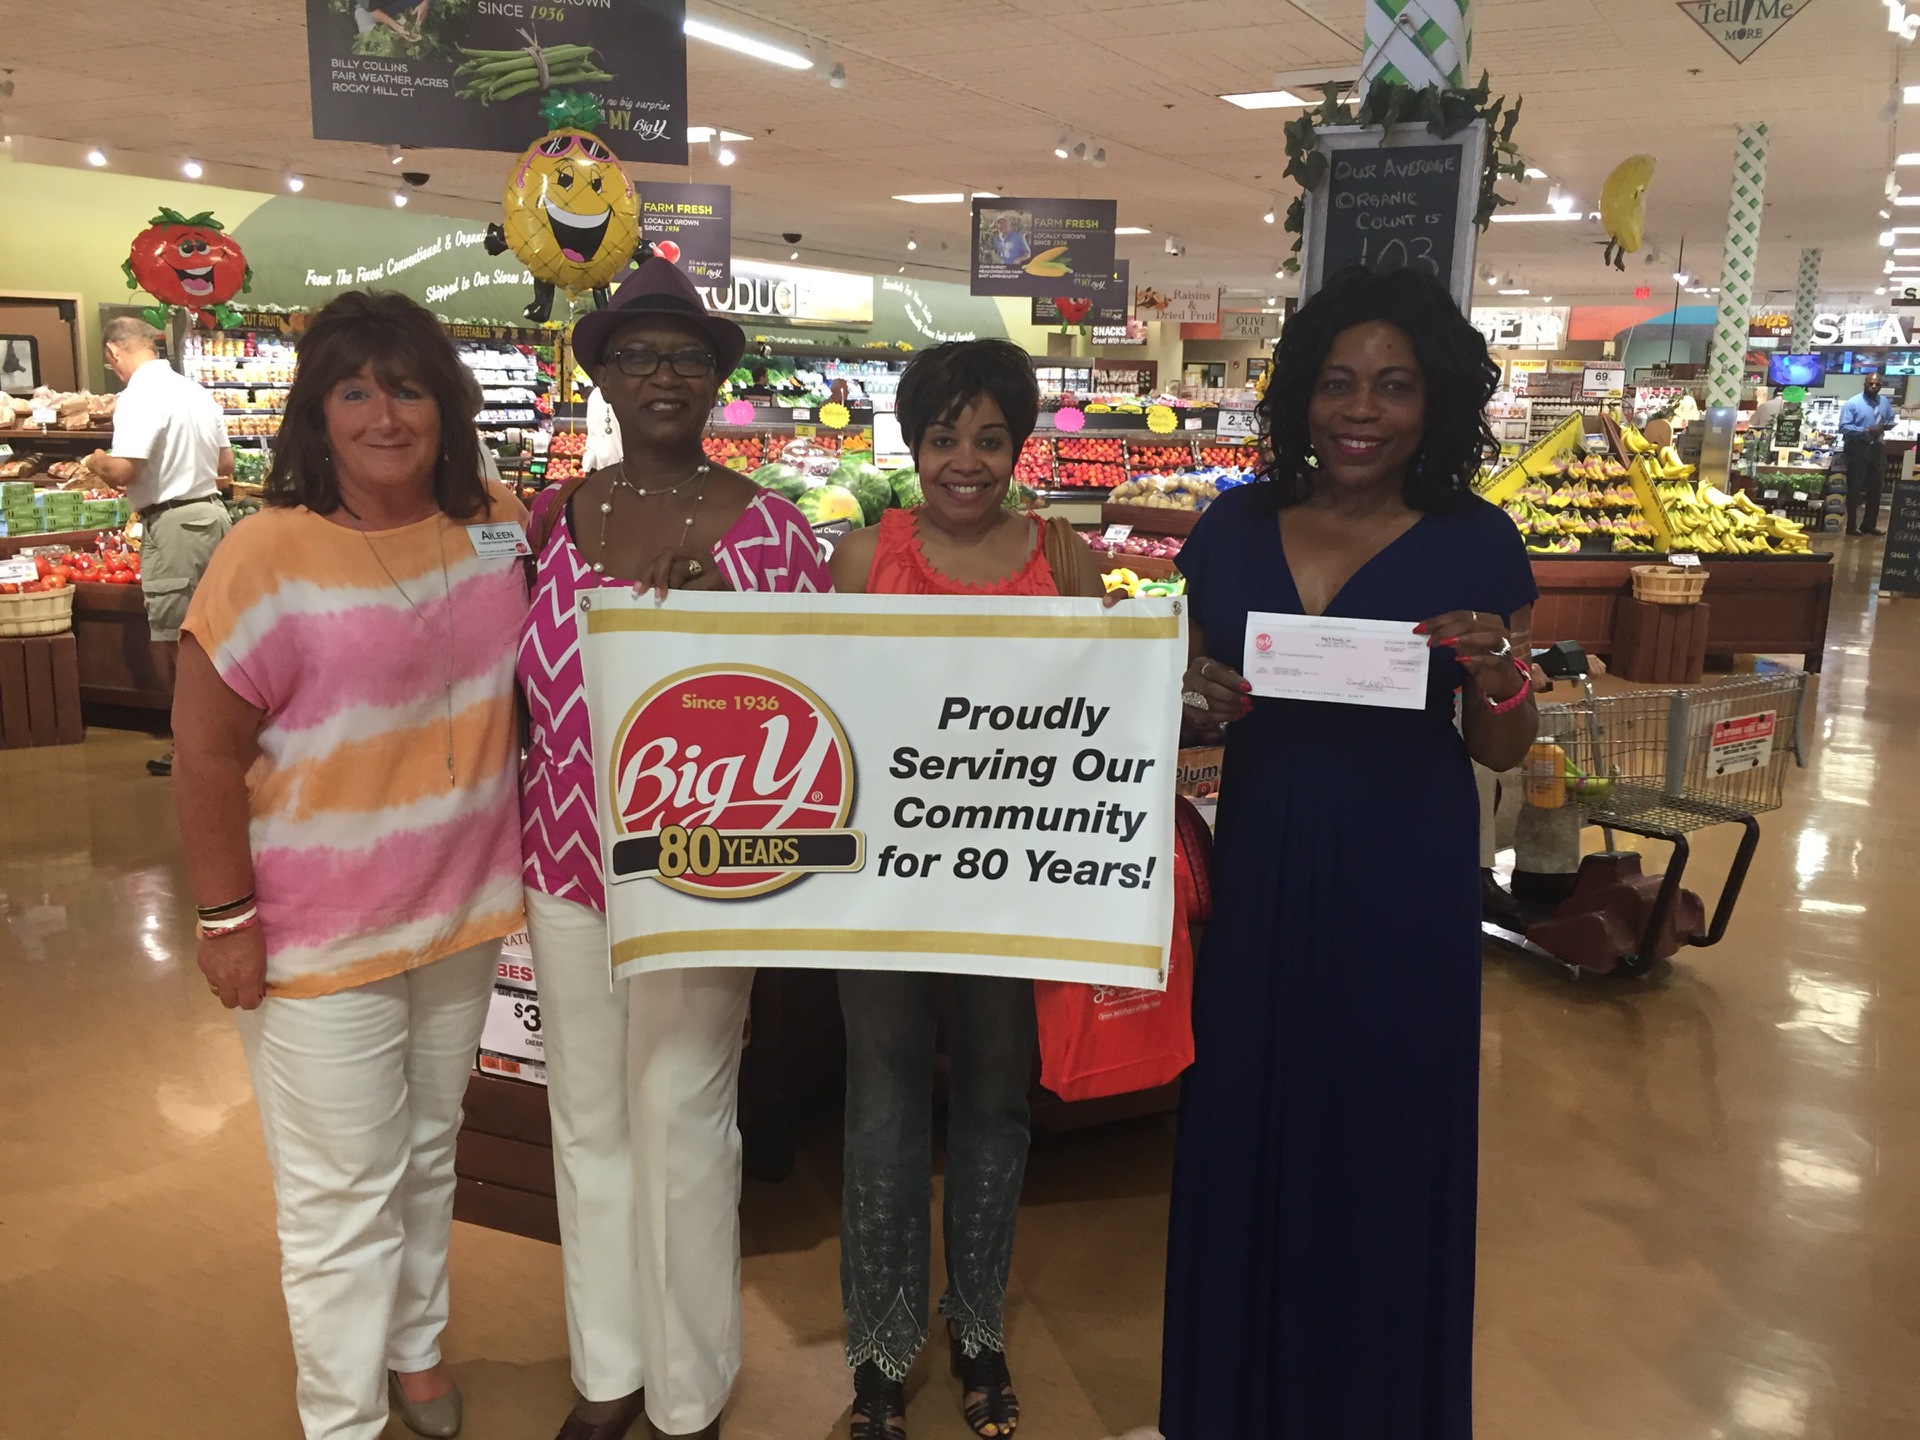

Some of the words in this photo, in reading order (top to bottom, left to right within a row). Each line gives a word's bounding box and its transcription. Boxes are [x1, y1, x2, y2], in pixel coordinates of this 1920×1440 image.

[478, 1, 523, 18] SINCE
[529, 5, 566, 22] 1936
[1698, 0, 1740, 25] Tell
[1755, 0, 1794, 21] Me
[1725, 28, 1763, 41] MORE
[331, 58, 360, 69] BILLY
[362, 61, 408, 73] COLLINS
[332, 71, 357, 81] FAIR
[359, 72, 412, 85] WEATHER
[414, 78, 449, 88] ACRES
[333, 83, 370, 93] ROCKY
[373, 86, 399, 97] HILL,
[400, 87, 415, 98] CT
[607, 98, 617, 106] no
[620, 97, 633, 110] big
[635, 100, 671, 112] surprise
[609, 110, 631, 131] MY
[644, 202, 674, 213] FARM
[677, 204, 713, 215] FRESH
[1034, 218, 1063, 228] FARM
[1065, 219, 1099, 229] FRESH
[305, 269, 332, 286] From
[336, 269, 353, 286] The
[356, 263, 384, 284] Finest
[386, 236, 442, 276] Conventional
[444, 233, 452, 250] &
[426, 277, 459, 303] Shipped
[461, 276, 470, 291] to
[473, 271, 490, 287] Our
[492, 269, 519, 284] Stores
[522, 270, 535, 285] Da
[1174, 289, 1211, 300] Raisins
[1188, 301, 1196, 310] &
[260, 313, 280, 327] FRUIT
[1156, 310, 1185, 320] Dried
[1190, 311, 1216, 321] Fruit
[1236, 316, 1266, 326] OLIVE
[1750, 313, 1788, 329] ups
[452, 326, 490, 338] VEGETABLES
[1093, 326, 1126, 336] SNACKS
[1241, 327, 1261, 335] BAR
[1772, 327, 1779, 335] to
[1781, 327, 1792, 336] go!
[1811, 313, 1920, 345] SEA
[1595, 372, 1609, 381] 69
[1228, 415, 1235, 425] 2
[1555, 415, 1578, 435] Organic
[1532, 436, 1553, 453] Organic
[1521, 454, 1531, 464] nic
[1493, 466, 1514, 484] Organic
[482, 531, 515, 540] AILEEN
[681, 693, 728, 711] Since
[733, 695, 780, 712] 1936
[937, 697, 1110, 738] Proudly
[618, 736, 747, 827] Big
[752, 710, 835, 830] Y
[889, 747, 1056, 787] Serving
[1072, 747, 1157, 784] Our
[892, 797, 1148, 843] Community
[658, 824, 721, 878] 80
[723, 837, 800, 865] YEARS
[876, 845, 937, 880] for
[952, 847, 1009, 881] 80
[1022, 849, 1158, 890] Years!
[497, 963, 534, 982] BES
[525, 1039, 544, 1048] CHERR
